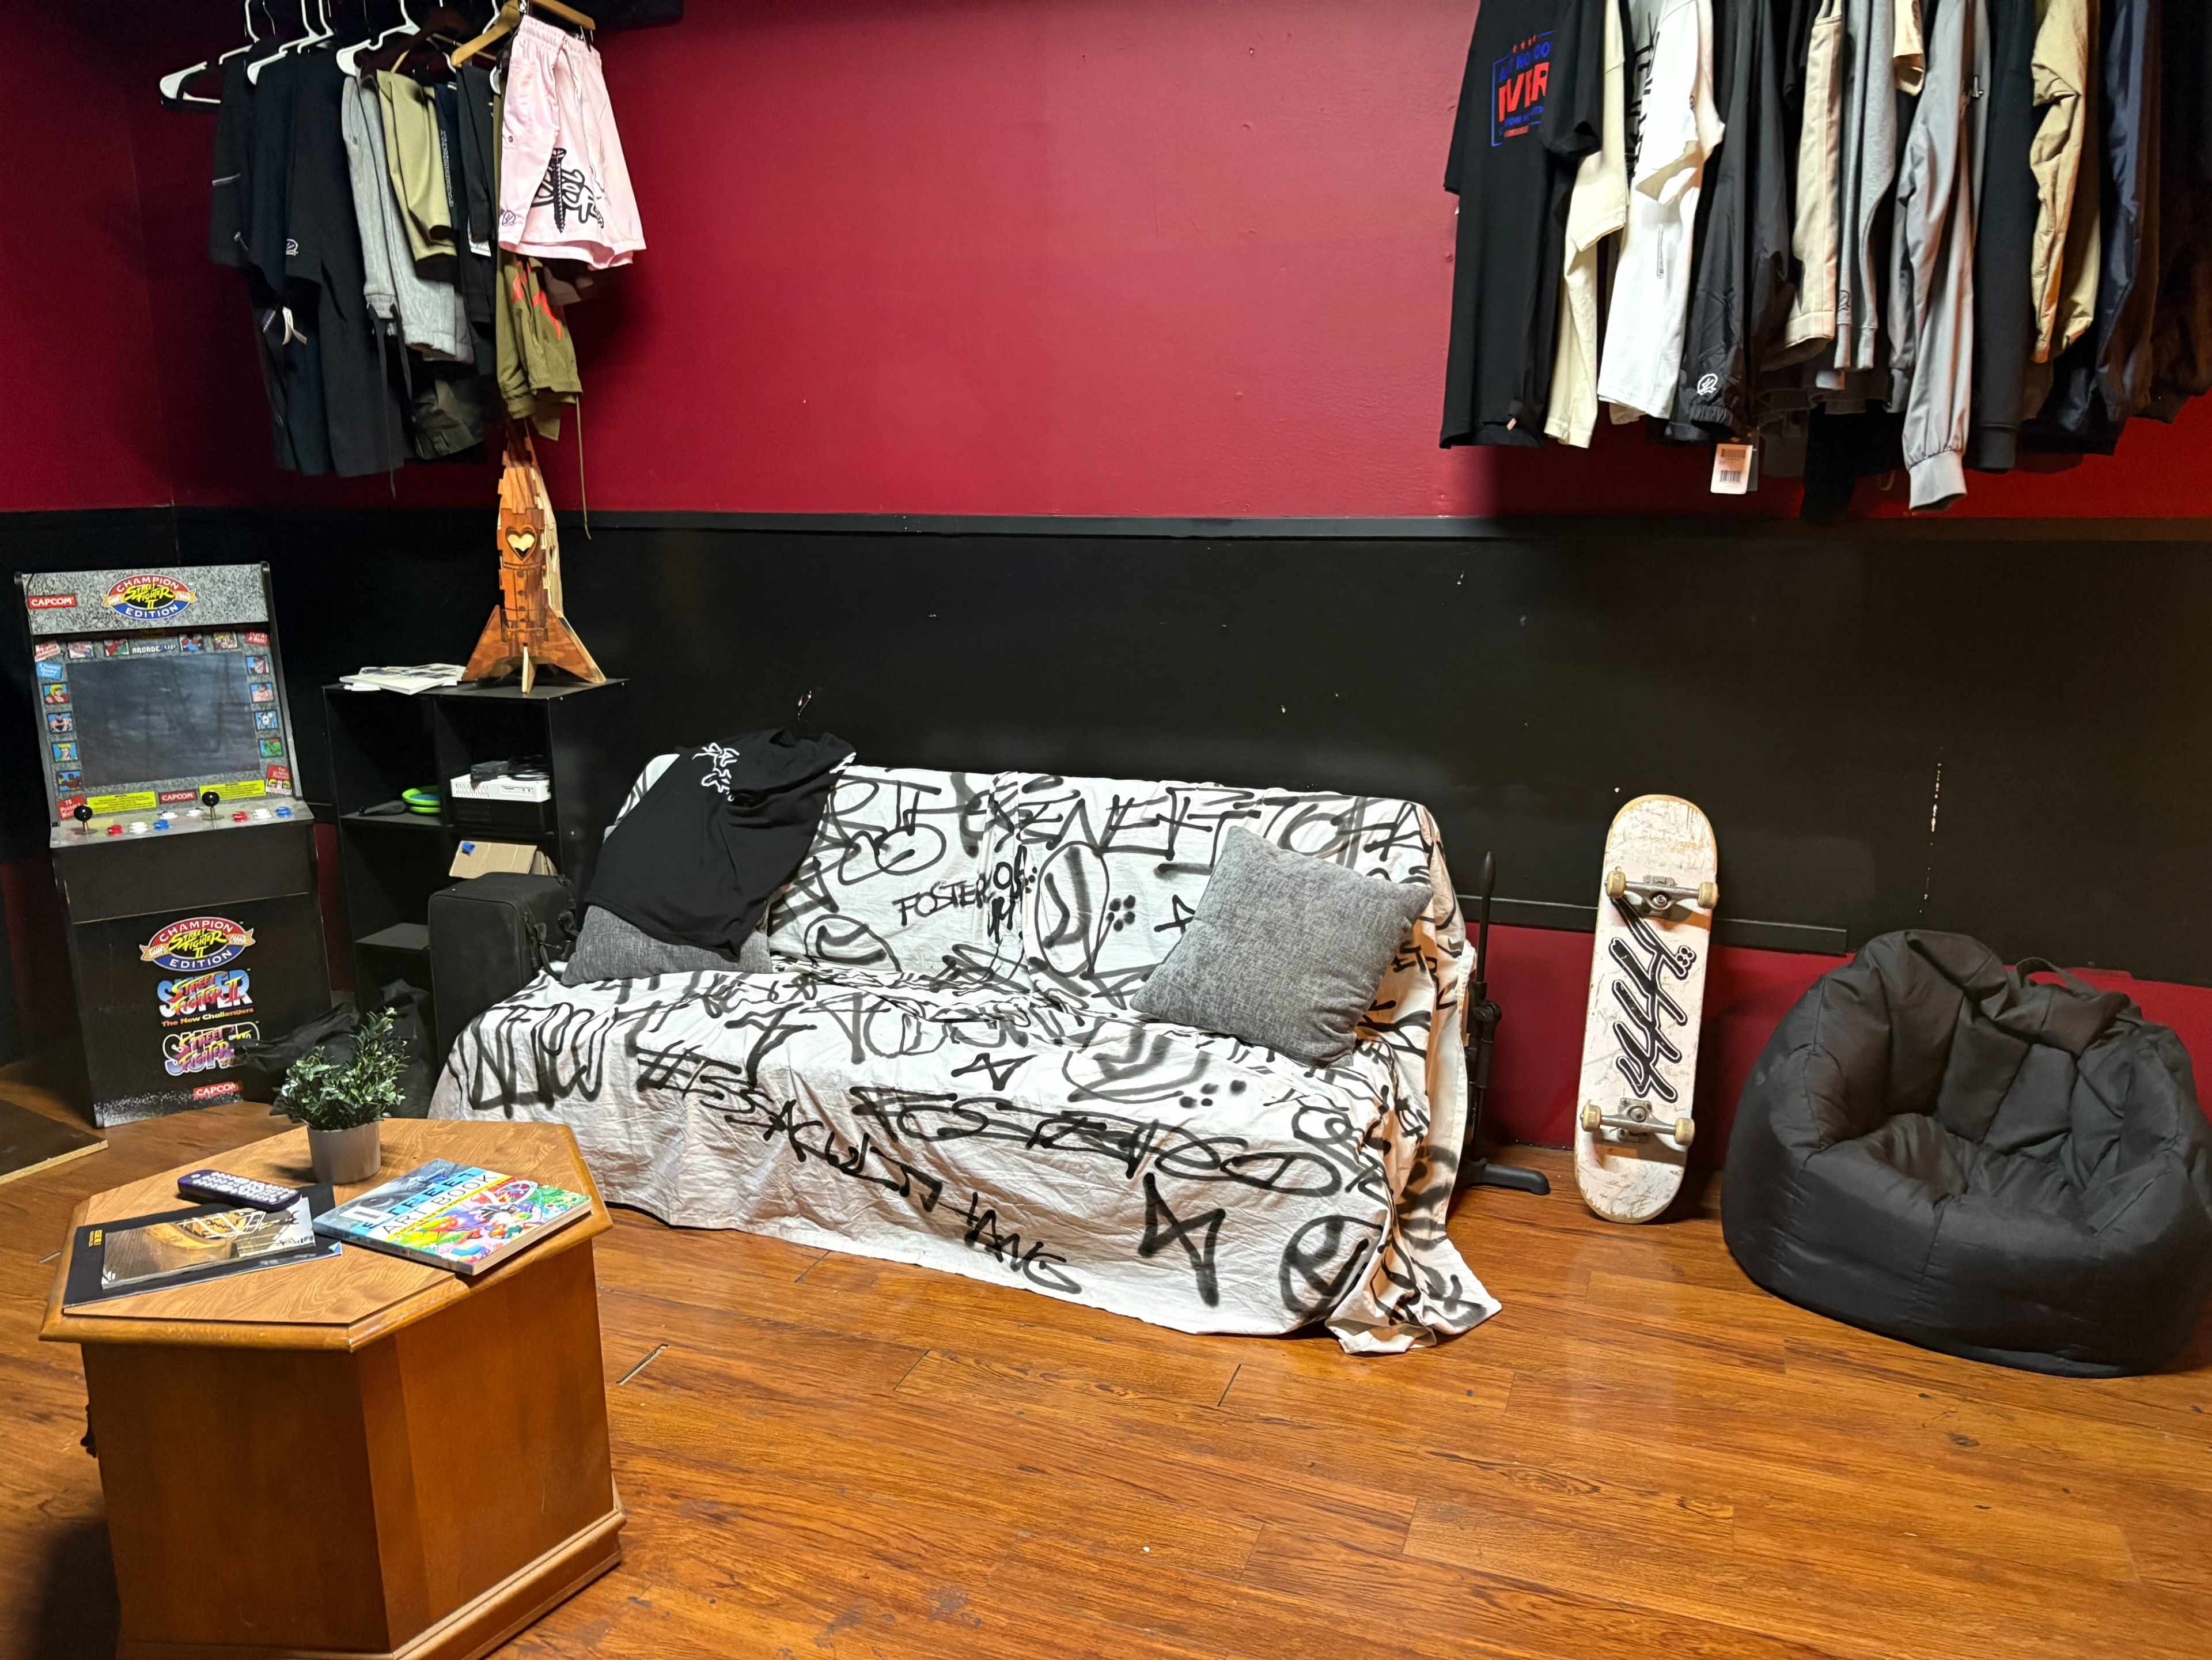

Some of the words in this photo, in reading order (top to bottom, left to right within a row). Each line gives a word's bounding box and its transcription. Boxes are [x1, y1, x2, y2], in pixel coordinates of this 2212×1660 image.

[116, 577, 179, 592] CHAMPION
[31, 597, 72, 606] CAPCOM
[125, 604, 179, 618] EDITION
[162, 792, 193, 801] CAPCOM
[159, 920, 233, 942] CHAMPION
[179, 930, 228, 951] FIGHTER
[169, 950, 232, 969] EDITION
[171, 985, 226, 1015] FIGHTER
[162, 1019, 179, 1027] The
[180, 1016, 200, 1024] New
[202, 1008, 254, 1020] Challengers
[179, 1039, 232, 1072] FIGHTER
[196, 1083, 238, 1096] CAPCOM
[382, 1207, 427, 1234] ART
[431, 1175, 498, 1205] BOOK
